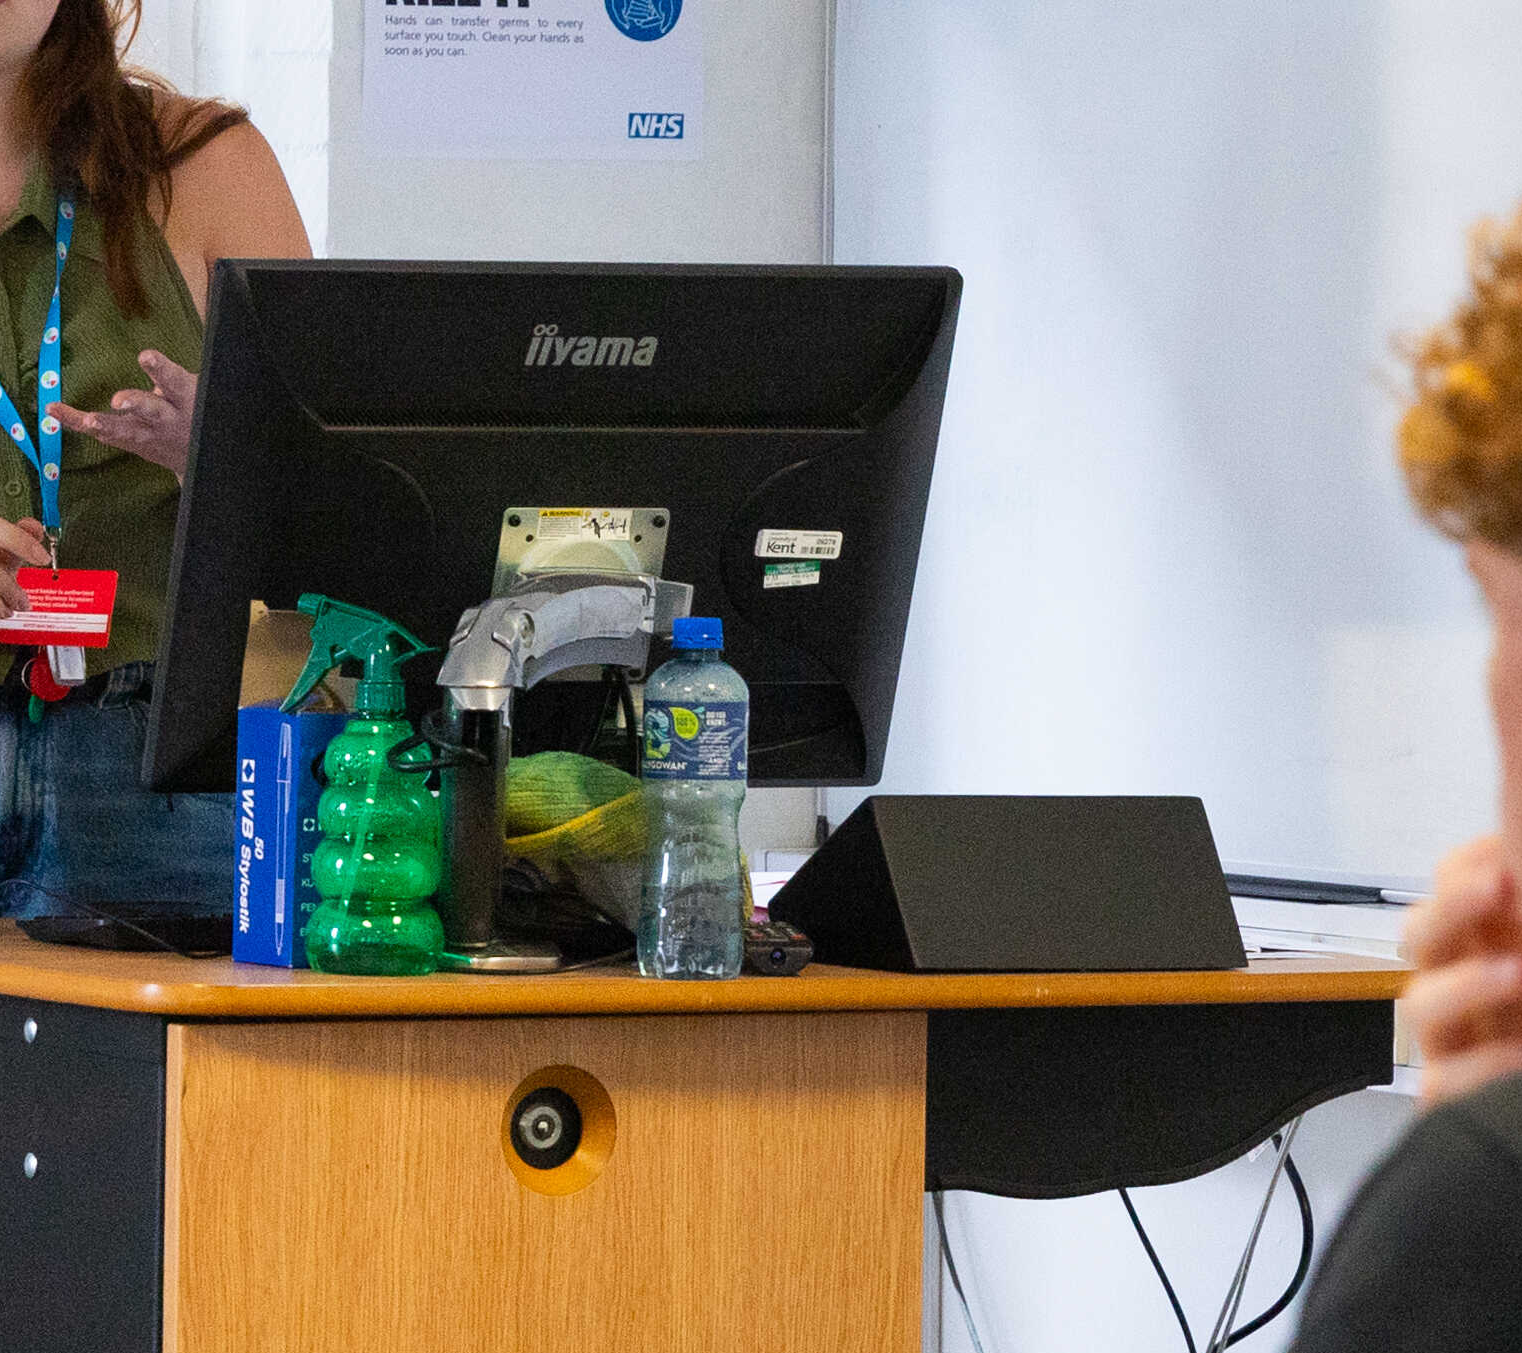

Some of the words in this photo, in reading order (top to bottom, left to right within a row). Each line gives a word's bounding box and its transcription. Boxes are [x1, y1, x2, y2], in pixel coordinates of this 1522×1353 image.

[385, 15, 417, 25] Hands
[425, 17, 442, 26] can
[451, 16, 490, 27] transfer
[498, 19, 529, 29] germs
[538, 19, 549, 27] to
[556, 21, 583, 31] every
[385, 31, 421, 40] surface
[425, 33, 443, 43] you
[482, 32, 510, 42] Clean
[514, 34, 536, 44] your
[540, 33, 570, 43] hands
[574, 35, 584, 44] as
[385, 47, 409, 55] soon
[412, 48, 423, 56] as
[425, 48, 443, 58] you
[629, 113, 683, 137] NHS
[524, 324, 658, 366] iiyama
[766, 541, 796, 554] Kent
[241, 789, 256, 840] WB
[254, 837, 265, 860] 50
[238, 843, 252, 934] Stylostik
